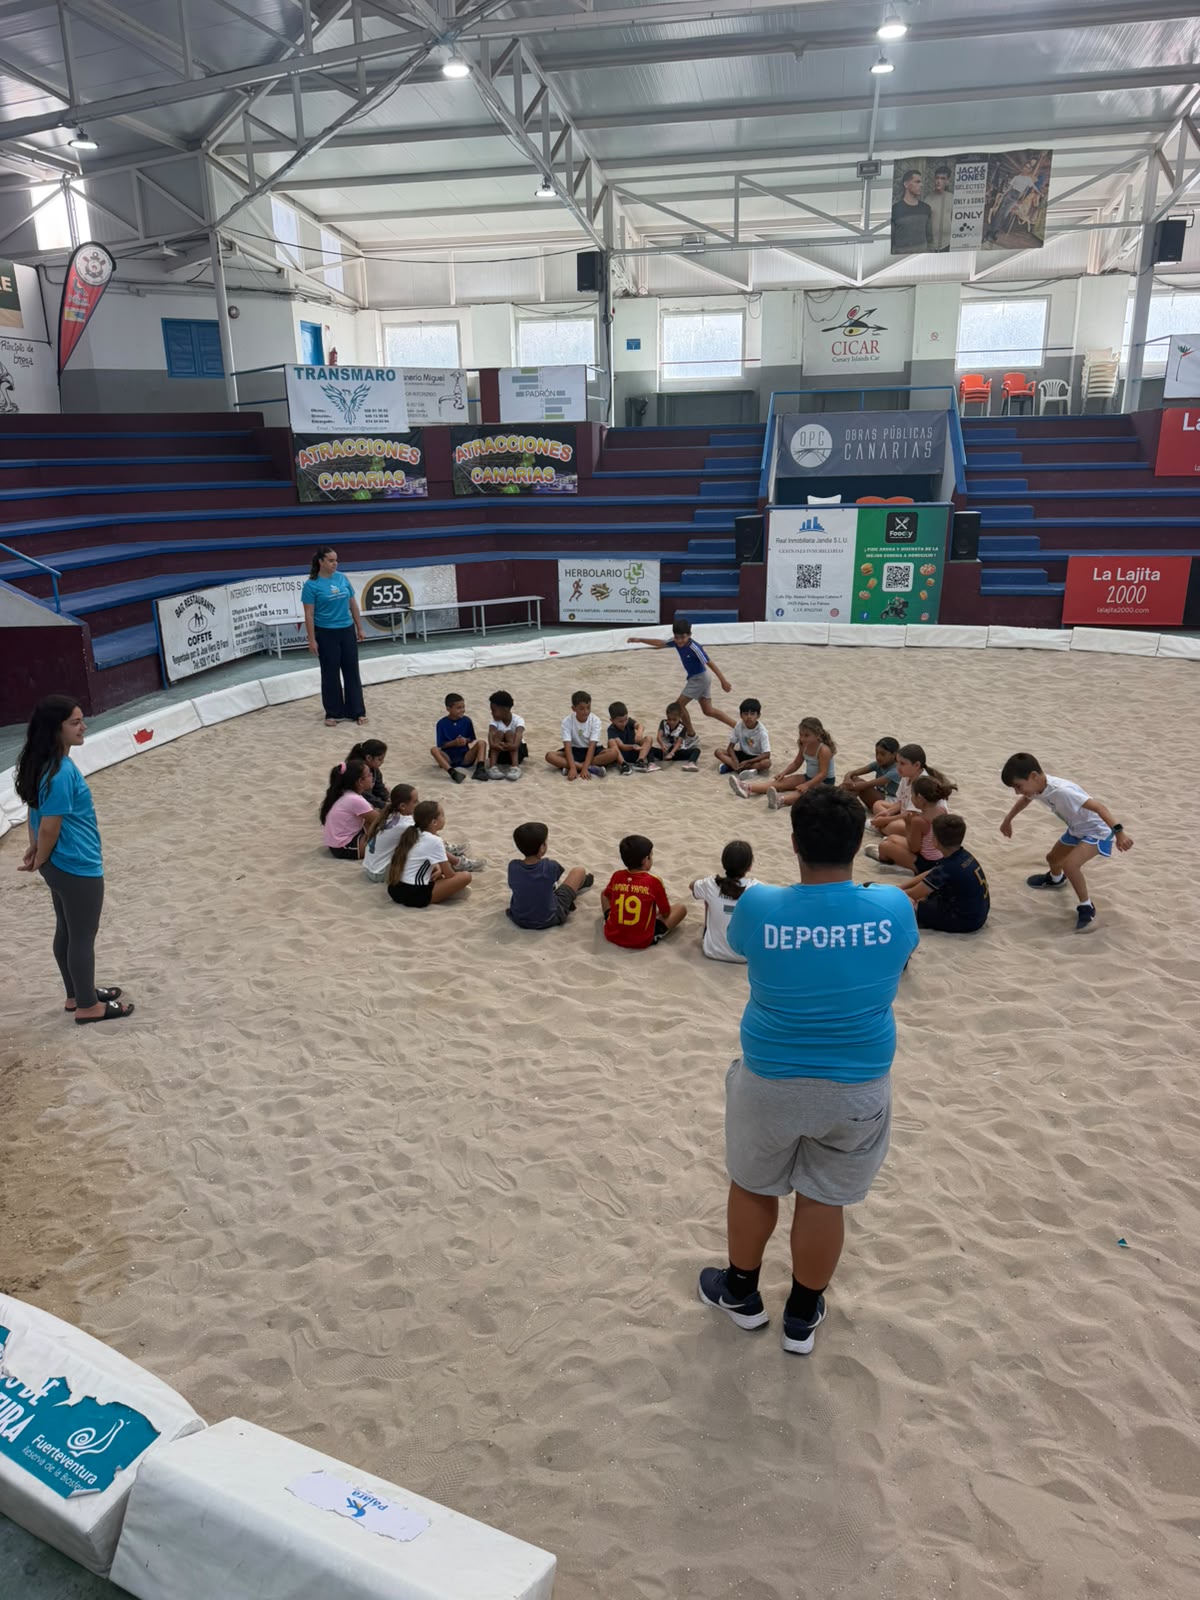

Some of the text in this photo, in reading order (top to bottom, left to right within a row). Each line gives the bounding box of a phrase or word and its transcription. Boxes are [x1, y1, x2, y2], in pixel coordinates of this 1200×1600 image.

[956, 165, 986, 174] JACK&
[956, 174, 986, 182] JONES
[954, 210, 983, 220] ONLY
[832, 340, 880, 356] CICAR
[294, 367, 396, 382] TRANSMARO
[423, 374, 445, 383] Miguel
[525, 388, 555, 397] PADRÓN
[800, 430, 824, 447] OPC
[845, 425, 933, 441] OBRAS PÚBLICAS
[298, 438, 420, 469] ATRACCIONES
[455, 435, 572, 463] ATRACCIONES
[844, 440, 932, 461] CANARIAS
[318, 470, 405, 490] CANARIAS
[471, 466, 556, 484] CANARIAS
[565, 568, 622, 578] HERBOLARIO
[1093, 567, 1160, 584] La Lajita
[372, 584, 403, 604] 555
[619, 587, 650, 596] Green
[1106, 585, 1147, 604] 2000
[174, 602, 185, 618] BAR
[184, 595, 216, 616] RESTAURANTE
[187, 630, 212, 647] COFETE
[631, 885, 650, 895] YAMAL
[615, 894, 641, 926] 19
[764, 919, 892, 950] DEPORTES
[22, 1446, 46, 1465] Reserva
[44, 1462, 55, 1473] de
[54, 1468, 62, 1477] la
[32, 1434, 98, 1485] Fuerteventura
